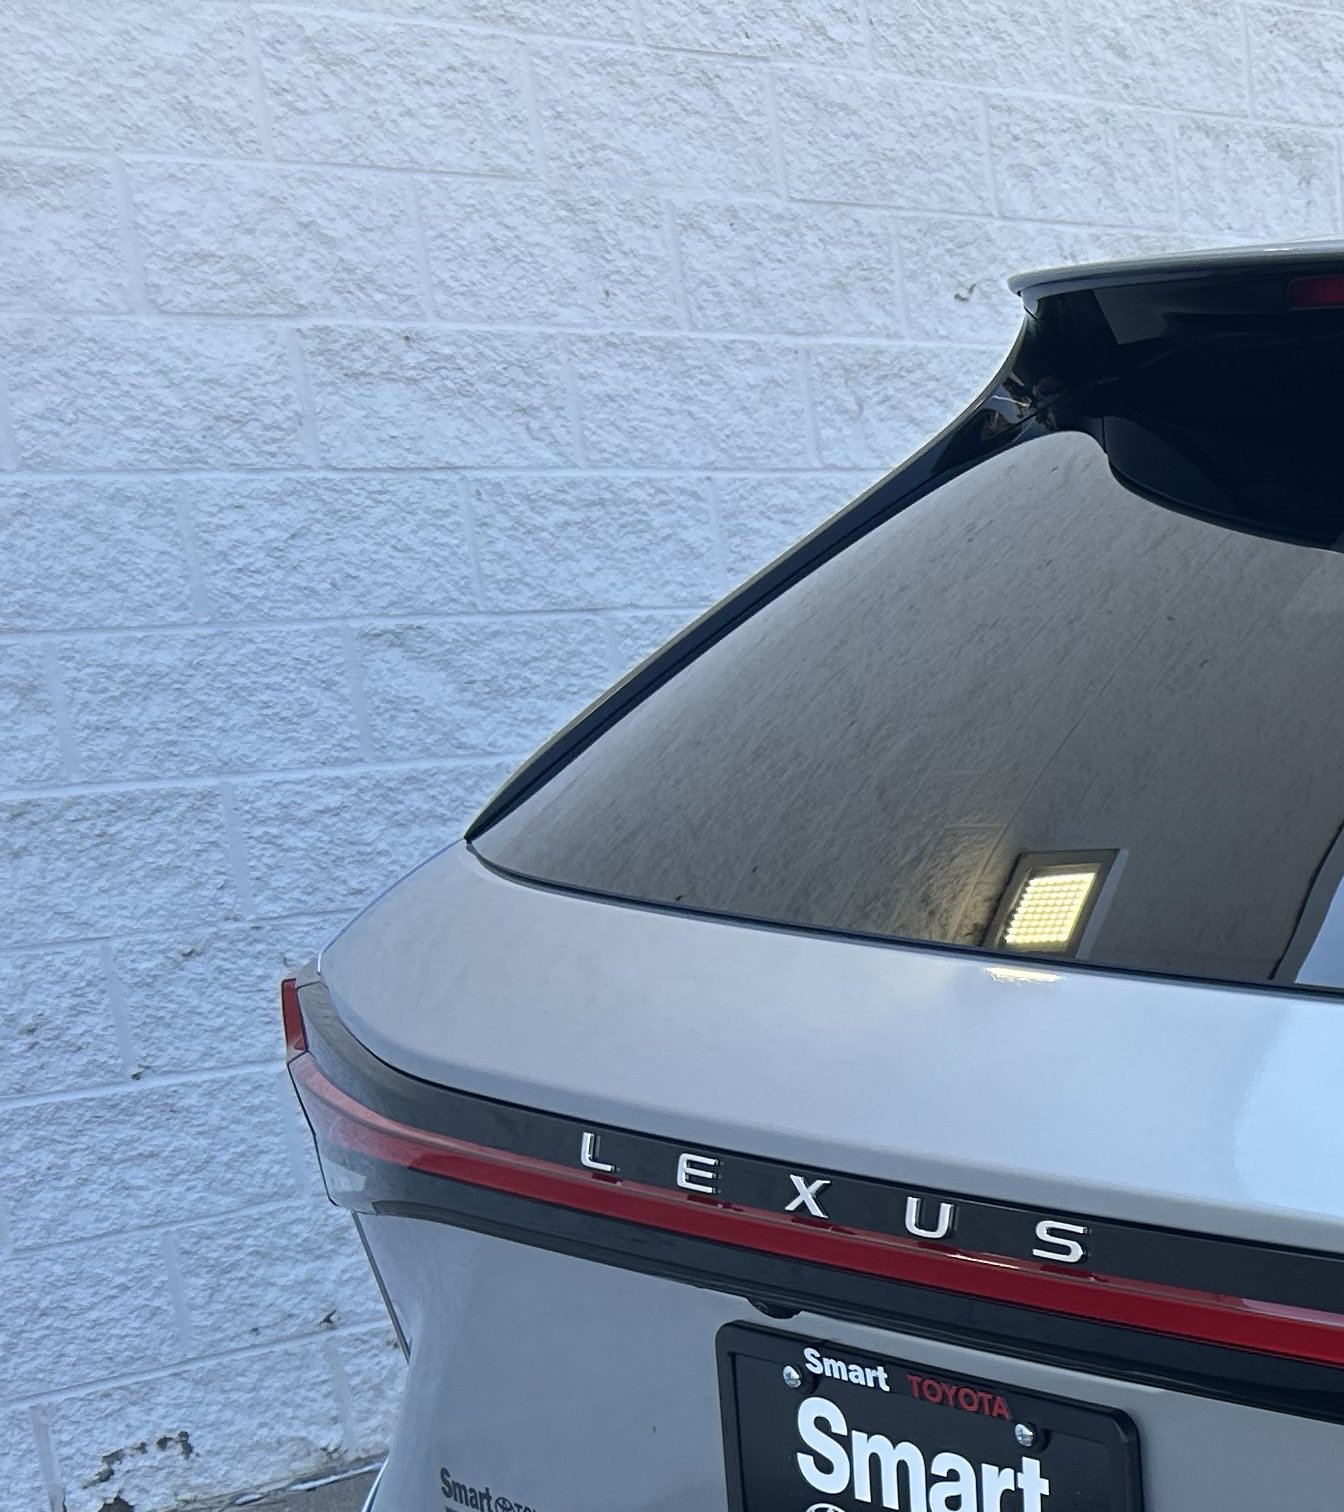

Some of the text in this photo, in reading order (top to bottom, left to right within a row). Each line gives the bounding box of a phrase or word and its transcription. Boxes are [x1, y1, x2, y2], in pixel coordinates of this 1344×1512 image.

[581, 1132, 1089, 1264] LEXUS
[804, 1347, 1012, 1420] Smart TOYOTA
